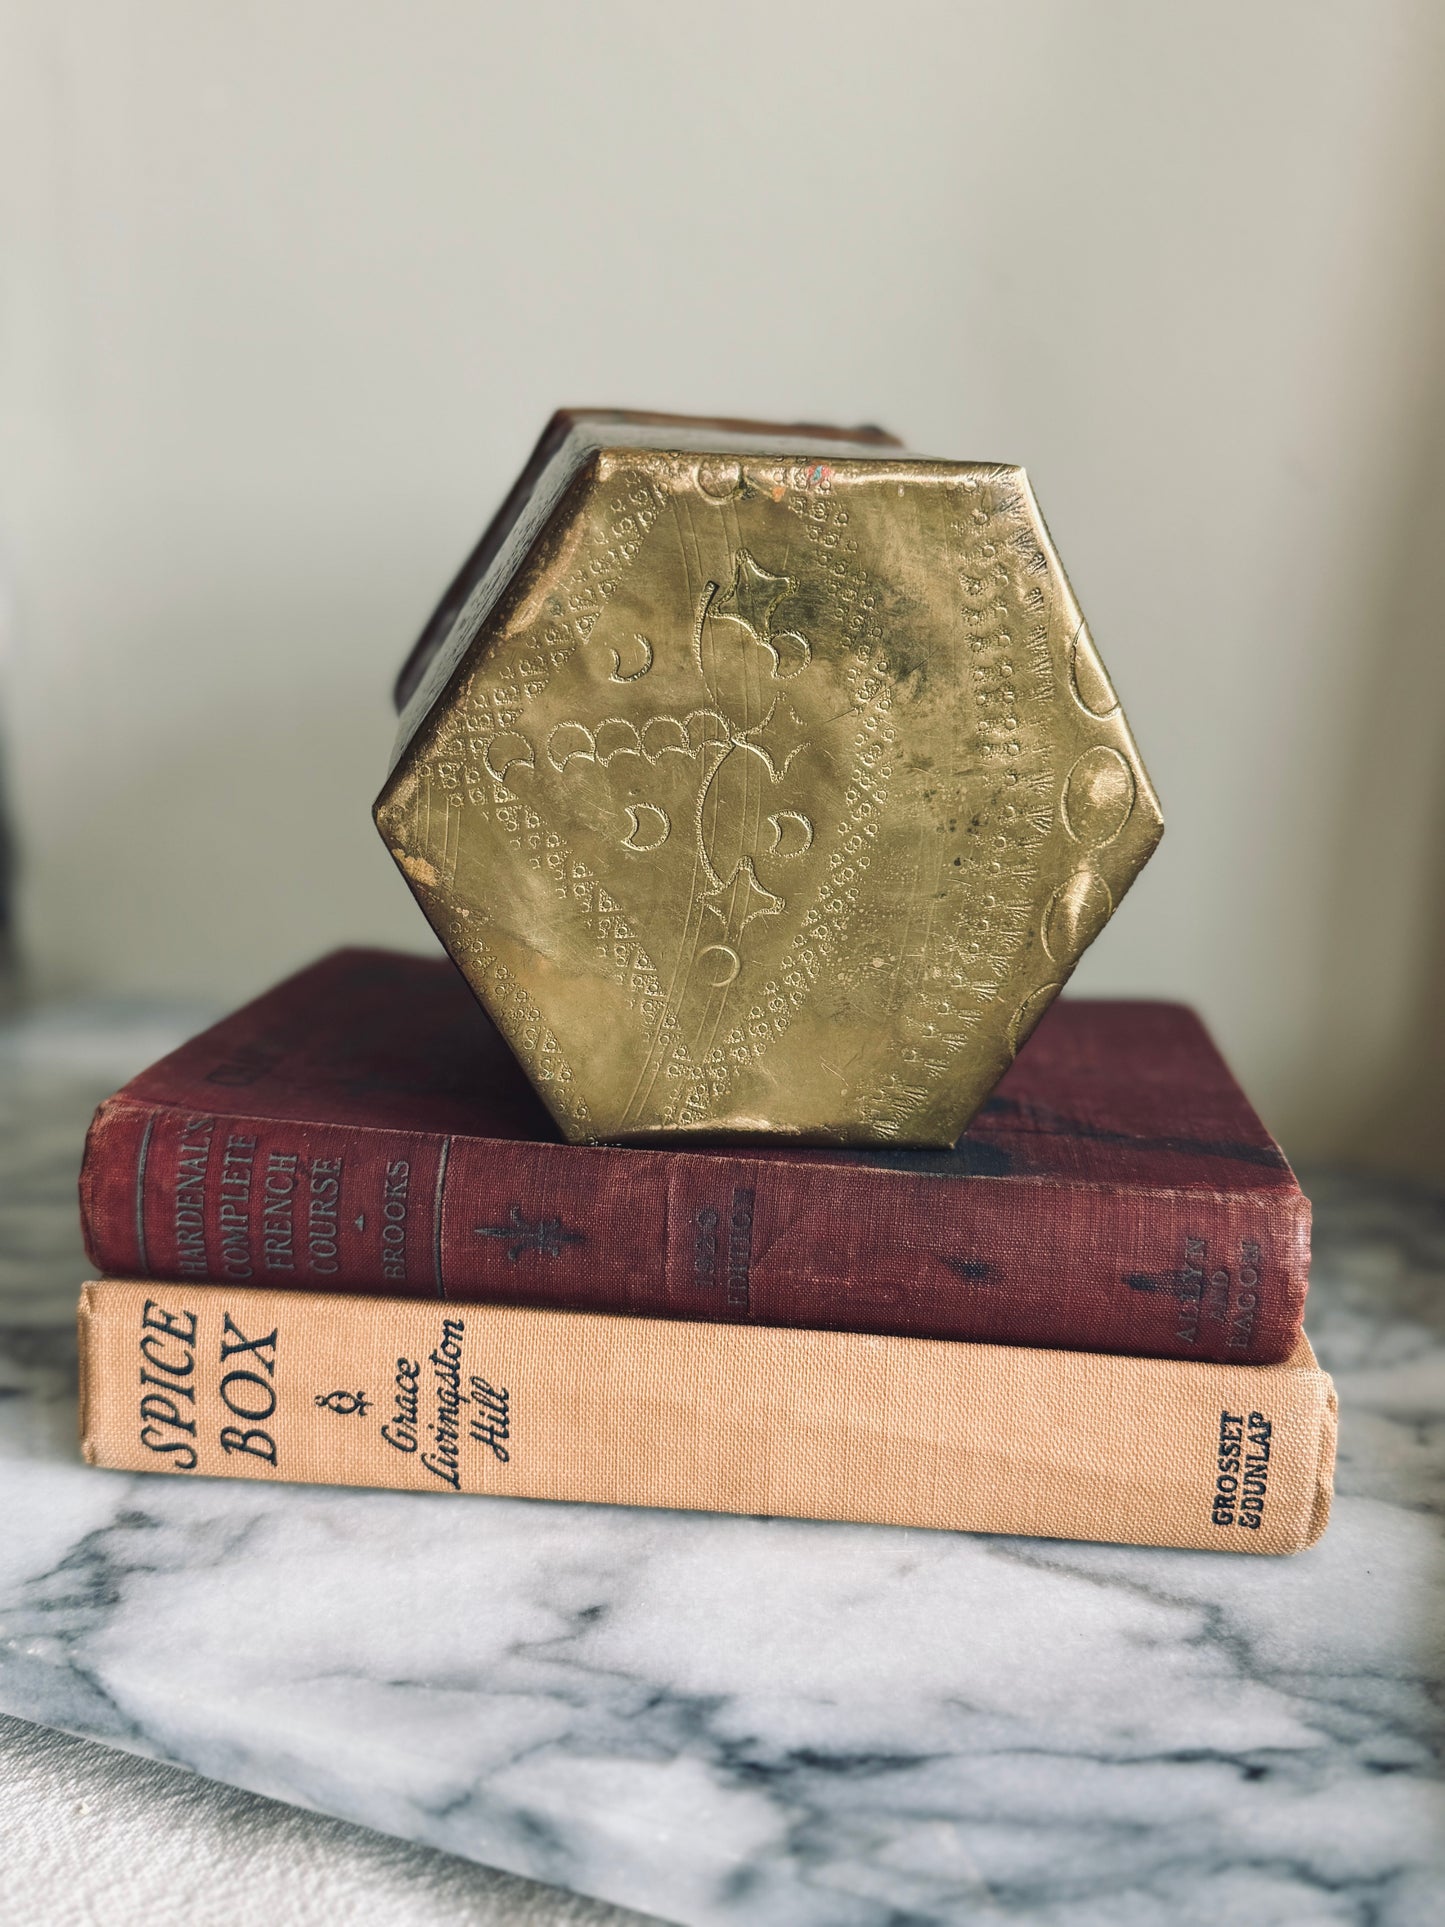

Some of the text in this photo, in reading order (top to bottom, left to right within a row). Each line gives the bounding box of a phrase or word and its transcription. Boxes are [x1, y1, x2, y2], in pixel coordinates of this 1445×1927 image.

[219, 1135, 258, 1279] COMPLETE
[263, 1153, 298, 1271] FRENCH
[308, 1157, 342, 1275] COURSE
[383, 1159, 410, 1279] BROOKS
[1176, 1236, 1206, 1343] ALLYN
[140, 1299, 198, 1470] SPICE
[219, 1311, 278, 1467] BOX
[381, 1357, 420, 1453] Grace
[420, 1318, 470, 1490] Livingston
[463, 1376, 511, 1463] Hill
[1211, 1410, 1243, 1525] GROSSET
